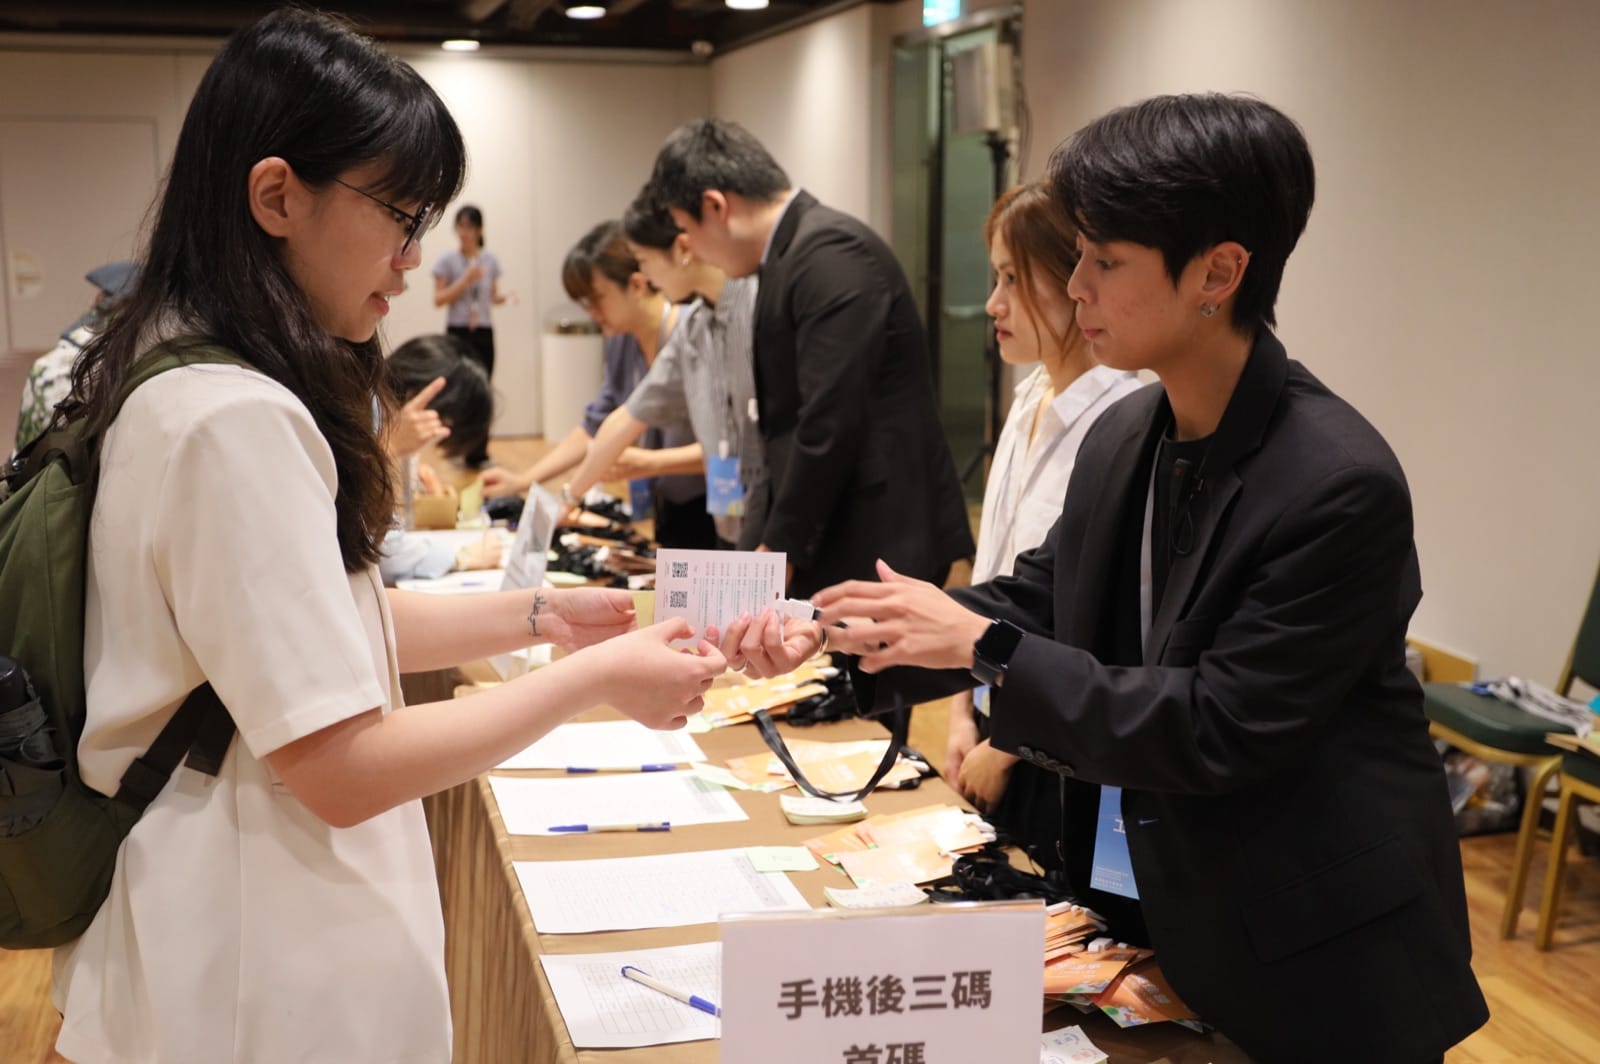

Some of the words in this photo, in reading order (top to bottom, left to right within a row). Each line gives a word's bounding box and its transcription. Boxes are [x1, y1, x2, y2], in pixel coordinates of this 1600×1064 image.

[778, 970, 992, 1020] 手機後三碼
